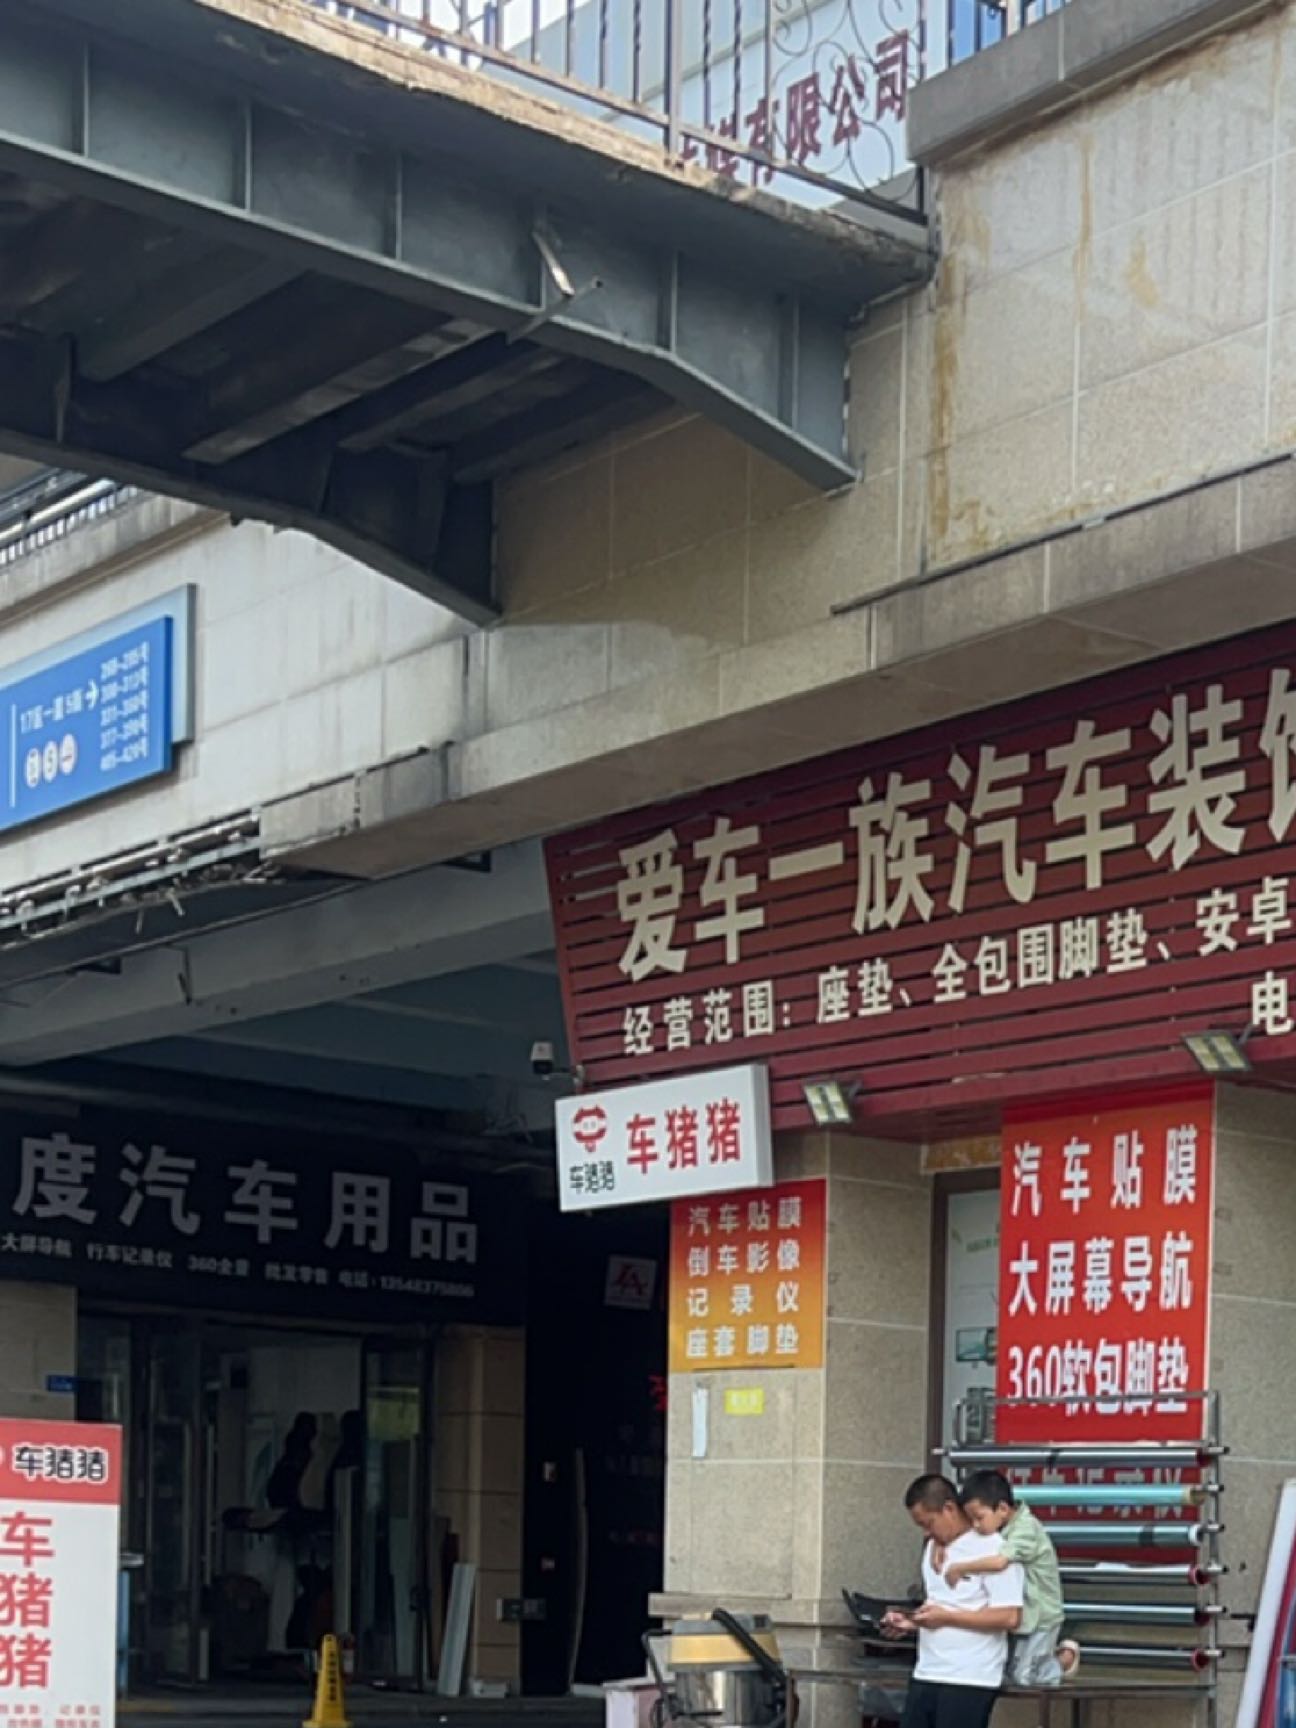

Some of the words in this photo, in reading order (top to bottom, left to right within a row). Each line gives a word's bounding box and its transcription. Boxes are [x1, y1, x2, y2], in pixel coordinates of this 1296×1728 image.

[626, 1097, 741, 1174] 车猪猪
[12, 1132, 478, 1264] 度汽车用品
[1012, 1124, 1198, 1217] 汽车贴膜
[688, 1197, 801, 1237] 汽车贴膜
[687, 1239, 800, 1278] 倒车影像
[1009, 1230, 1193, 1316] 大屏幕导航
[687, 1281, 799, 1317] 记录仪
[686, 1323, 799, 1359] 座套脚垫
[1008, 1337, 1189, 1416] 360软包脚垫
[15, 1446, 106, 1481] 车猪猪
